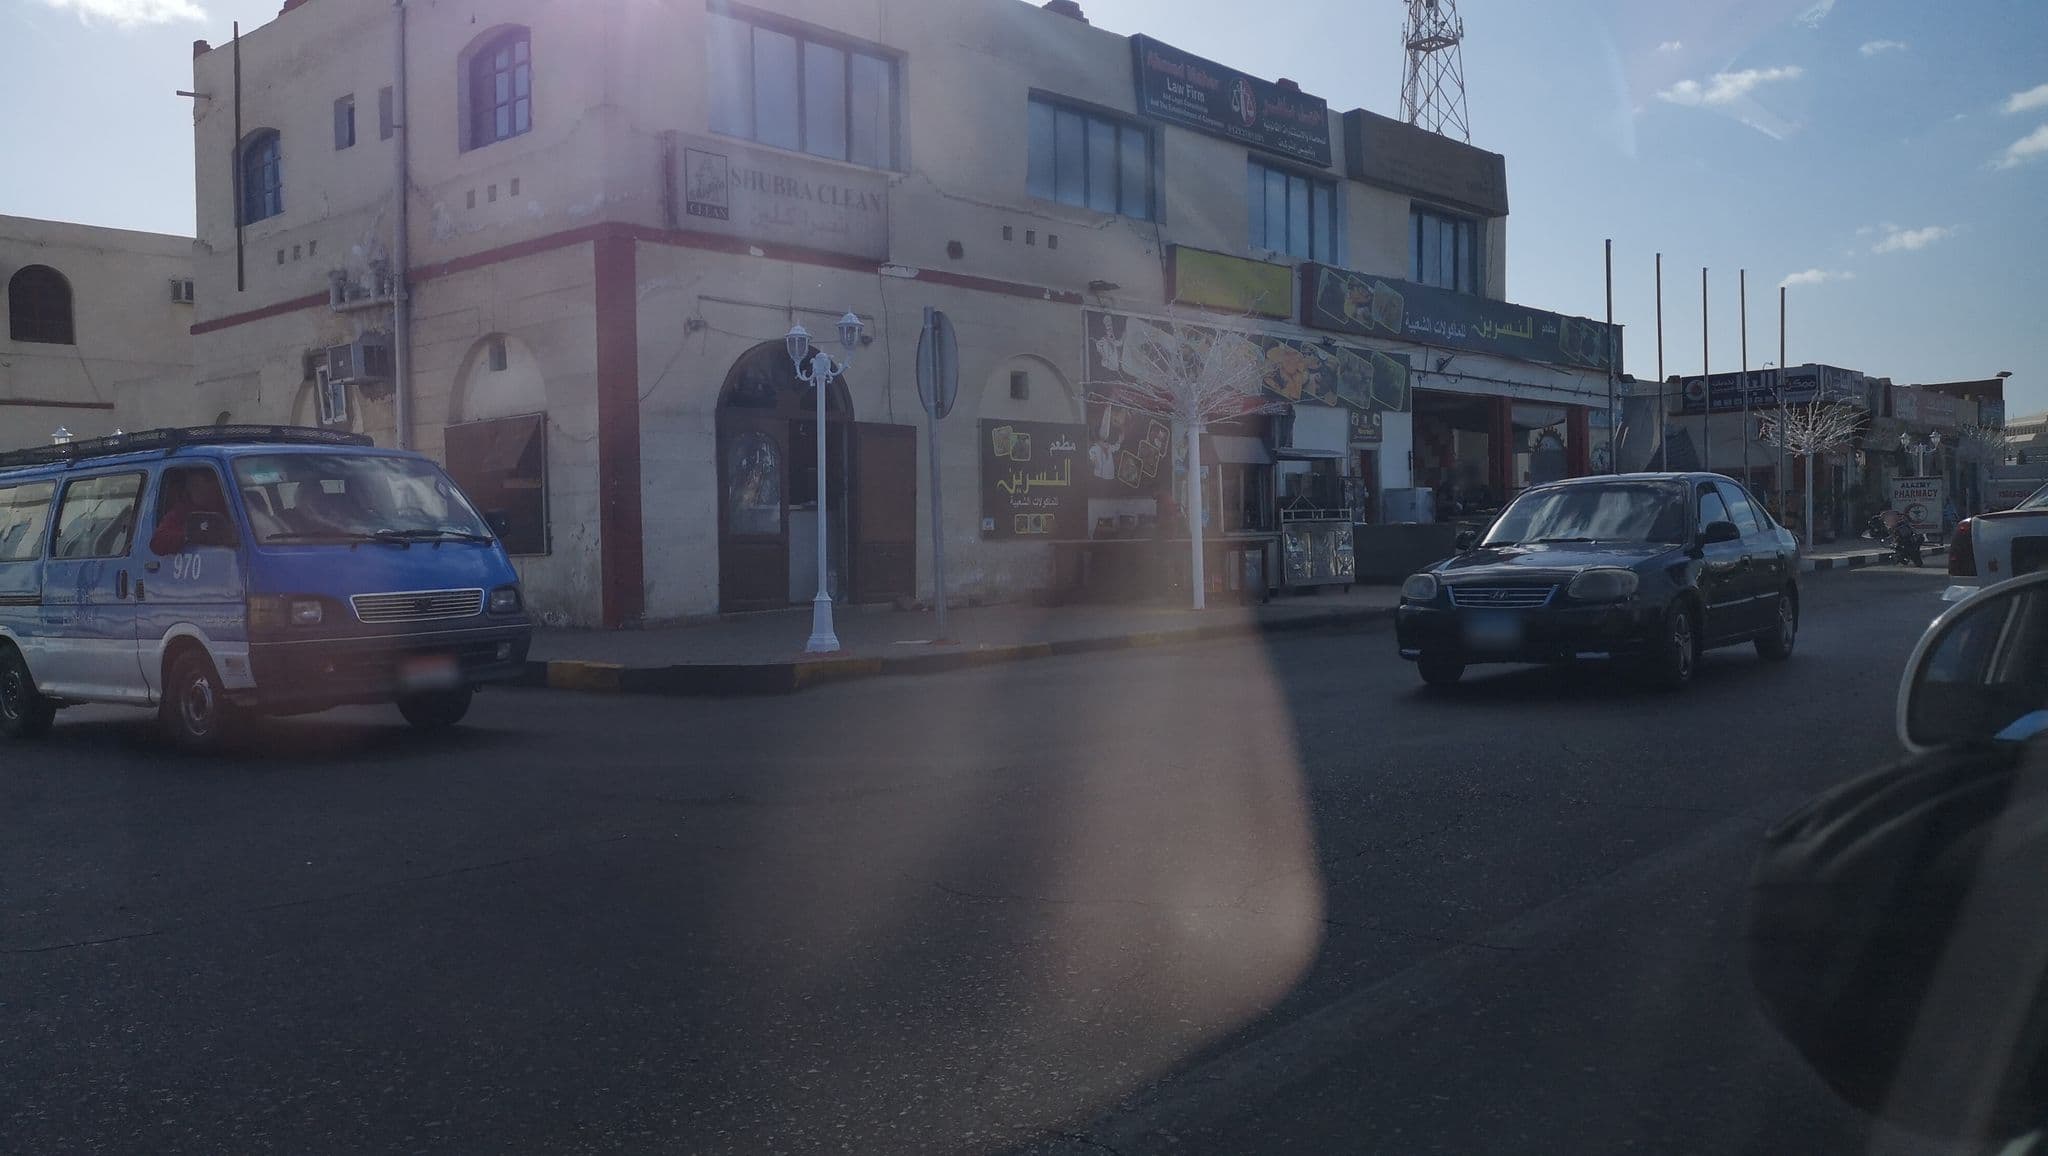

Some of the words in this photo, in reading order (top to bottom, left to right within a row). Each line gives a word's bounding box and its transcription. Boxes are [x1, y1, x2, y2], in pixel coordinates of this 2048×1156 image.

[1166, 77, 1184, 96] Law
[1185, 84, 1205, 105] Firm
[731, 168, 812, 201] SHUBRA
[818, 184, 882, 213] CLEAN
[688, 203, 728, 219] CLEAN
[1471, 314, 1533, 340] النسرين
[1049, 434, 1076, 456] مطعم
[996, 457, 1071, 494] النسرين
[1894, 489, 1938, 499] PHARMACY
[173, 553, 201, 580] 970
